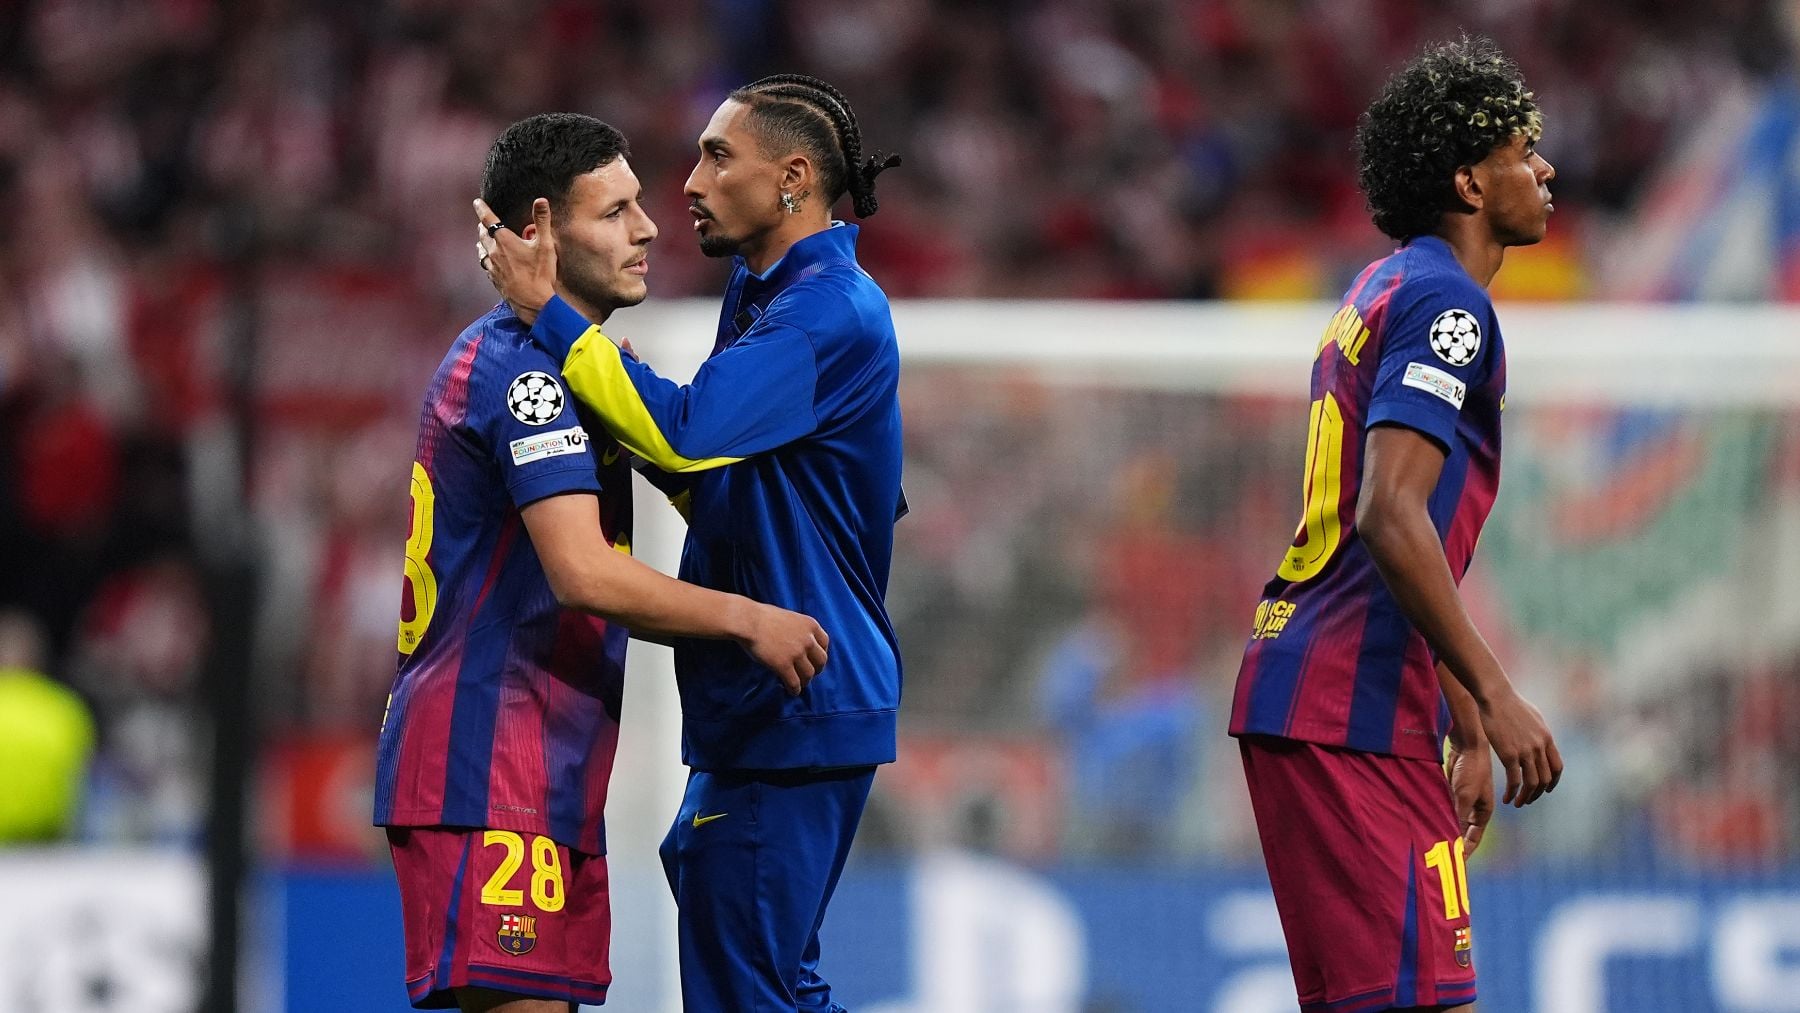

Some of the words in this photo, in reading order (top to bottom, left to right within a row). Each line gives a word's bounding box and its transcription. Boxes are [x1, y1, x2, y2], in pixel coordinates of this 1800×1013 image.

[1450, 326, 1466, 347] 5
[528, 387, 545, 409] 5
[513, 439, 564, 457] FOUNDATION
[481, 830, 565, 912] 28
[1424, 836, 1470, 920] 10
